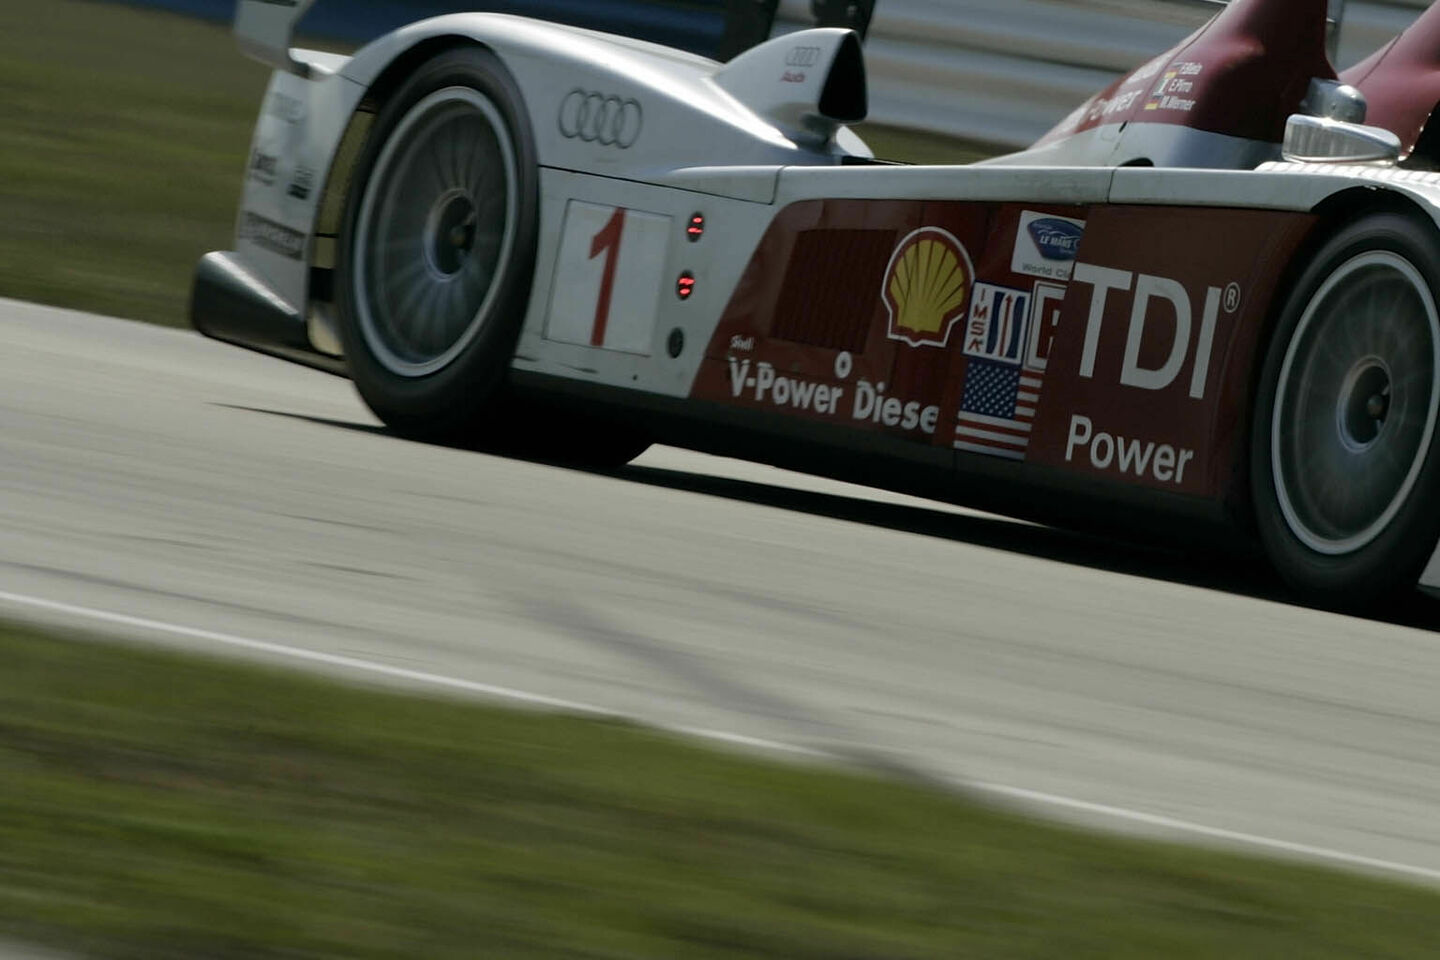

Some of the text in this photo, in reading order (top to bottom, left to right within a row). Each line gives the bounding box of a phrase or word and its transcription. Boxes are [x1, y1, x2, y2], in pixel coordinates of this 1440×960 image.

[588, 206, 627, 347] 1
[727, 356, 843, 414] V-Power
[1065, 414, 1194, 483] Power
